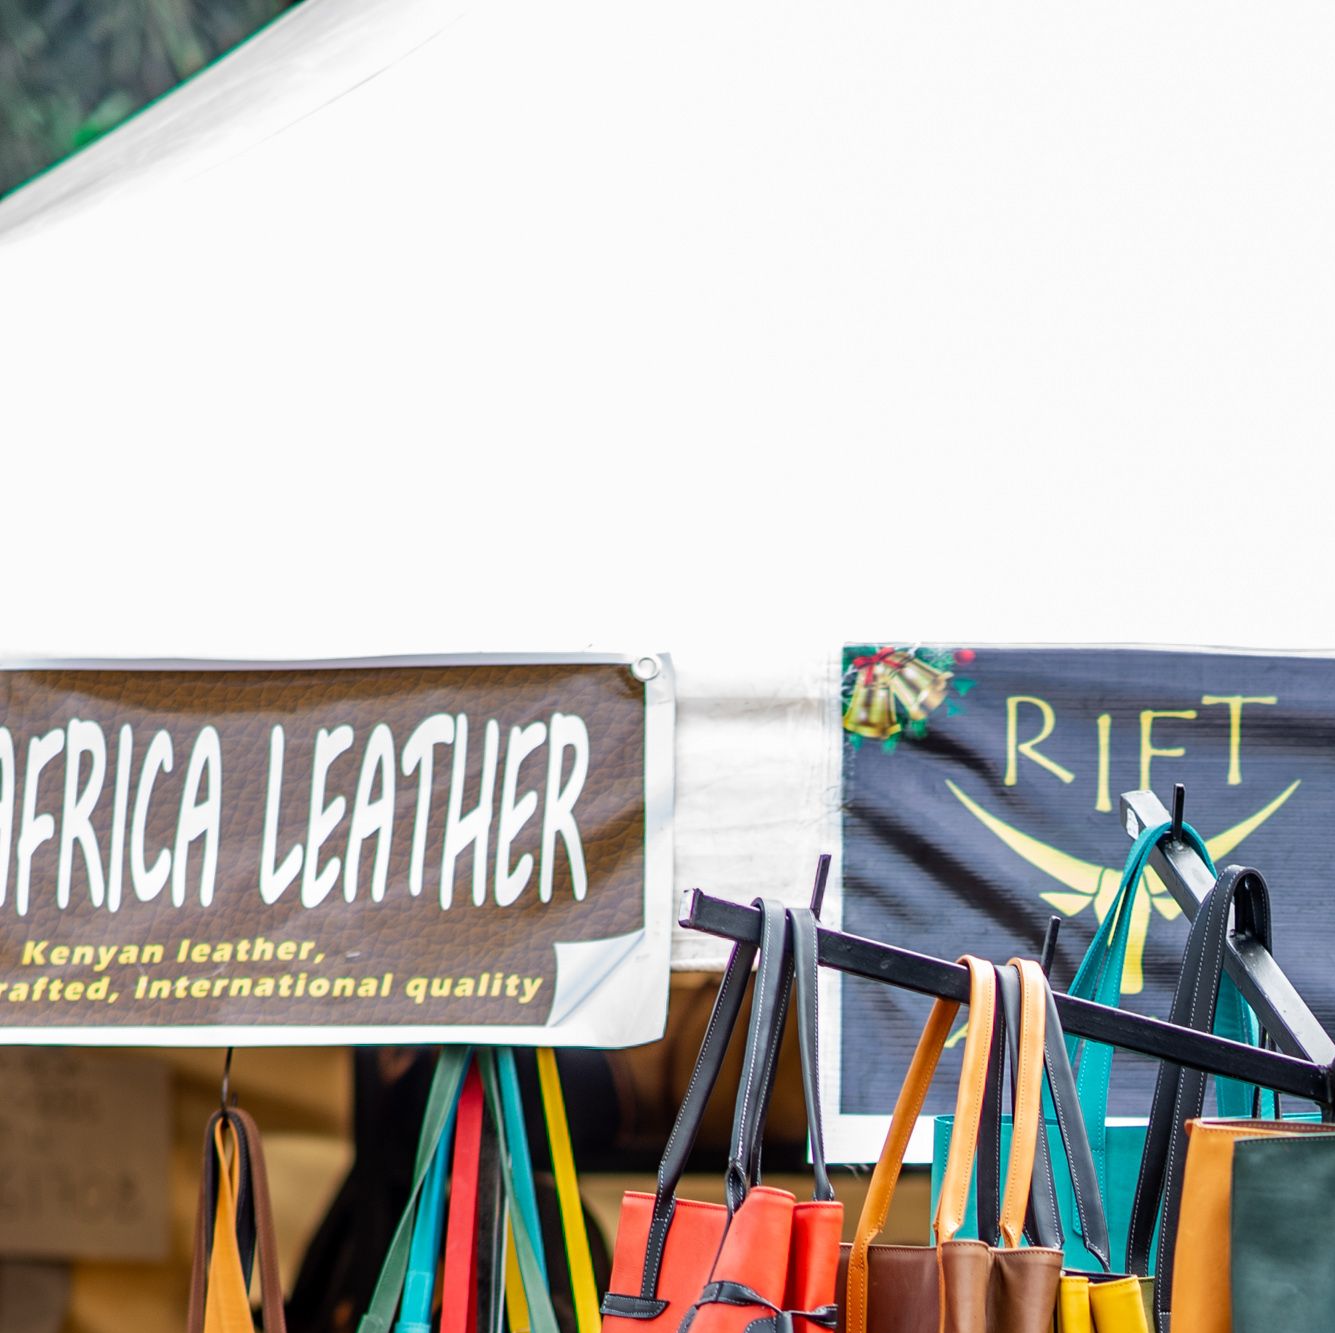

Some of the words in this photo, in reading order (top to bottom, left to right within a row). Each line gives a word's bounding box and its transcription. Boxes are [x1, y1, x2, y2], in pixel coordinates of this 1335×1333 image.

[1003, 695, 1278, 812] RIFT
[259, 712, 589, 910] LEATHER
[22, 939, 164, 973] Kenyan
[176, 936, 326, 965] leather,
[134, 972, 394, 1000] International
[405, 972, 543, 1005] quality
